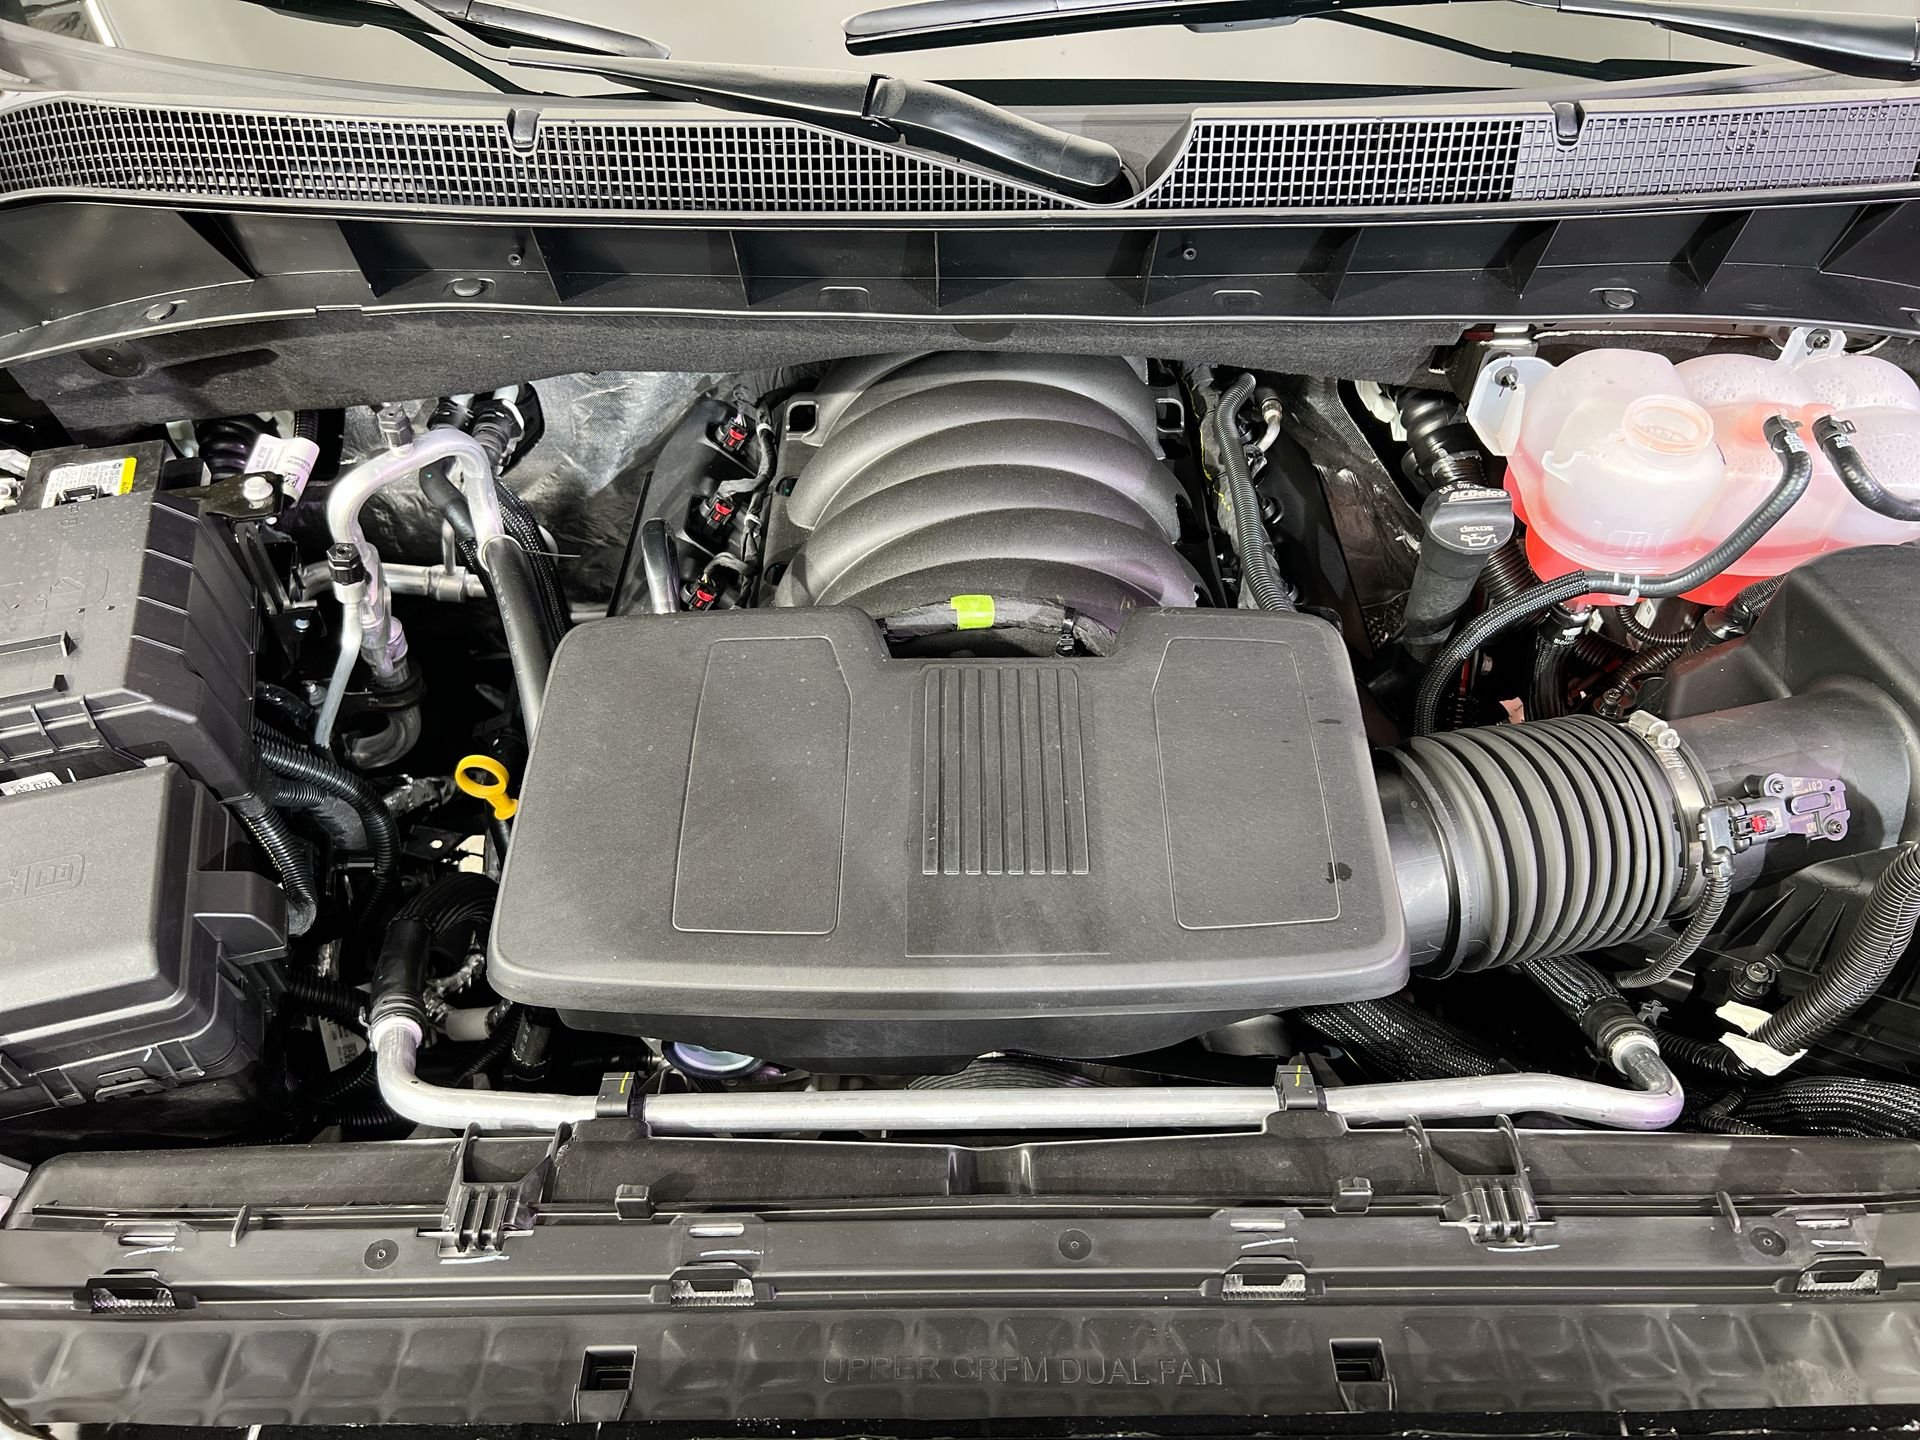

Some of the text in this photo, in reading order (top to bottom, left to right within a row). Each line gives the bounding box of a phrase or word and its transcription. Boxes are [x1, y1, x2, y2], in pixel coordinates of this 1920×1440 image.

[1438, 484, 1455, 494] SAE
[1448, 489, 1507, 501] ACDelco
[1460, 525, 1494, 533] dexos
[822, 1355, 942, 1384] UPPER
[1058, 1356, 1151, 1385] DUAL
[1158, 1357, 1224, 1386] FAN
